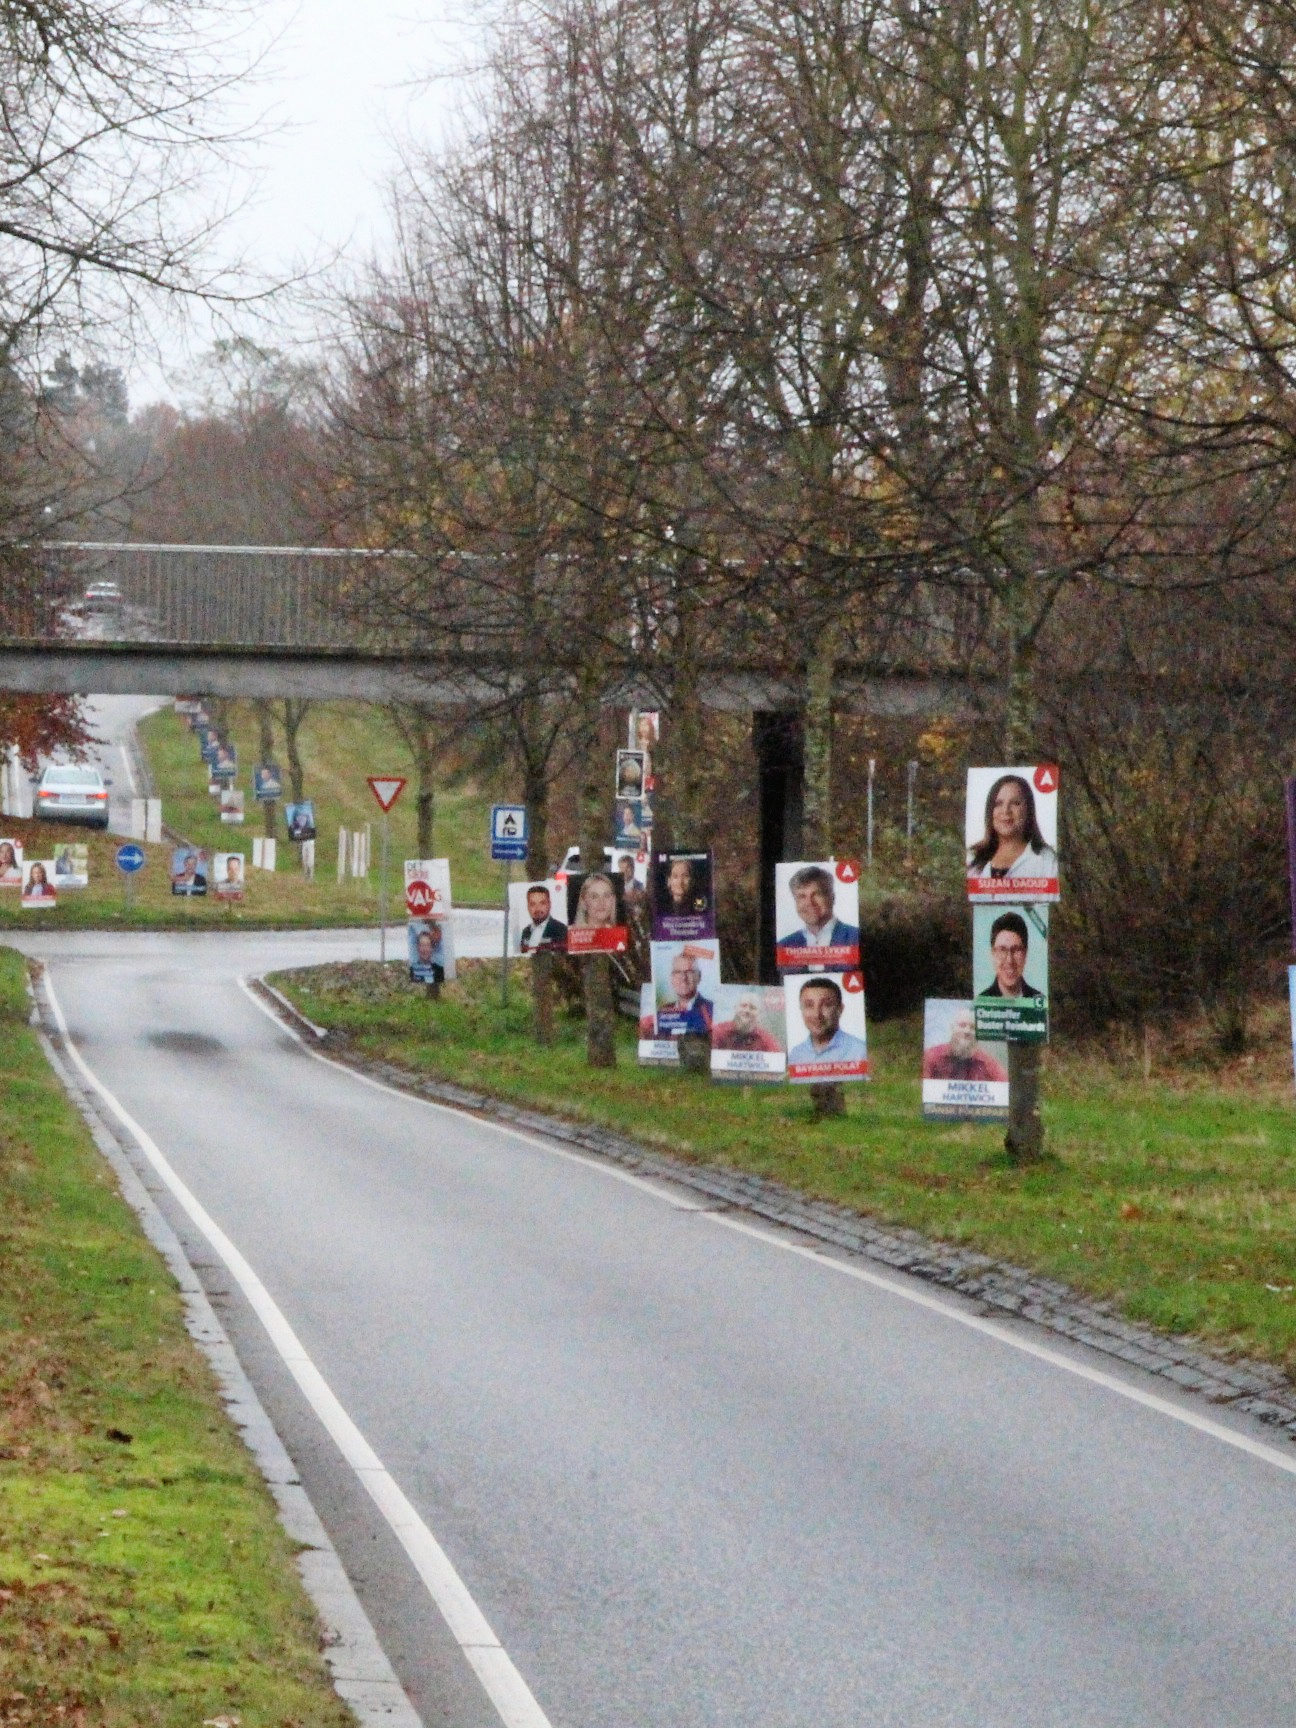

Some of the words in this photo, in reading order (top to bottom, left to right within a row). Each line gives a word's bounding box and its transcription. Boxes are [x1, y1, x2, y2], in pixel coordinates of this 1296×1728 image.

[1039, 770, 1053, 786] A
[842, 865, 853, 877] A
[978, 878, 1010, 888] SUZAN
[1013, 878, 1048, 888] DAOUD
[850, 975, 859, 987] A
[947, 1082, 990, 1093] MIKKEL
[942, 1093, 995, 1103] HARTWICH
